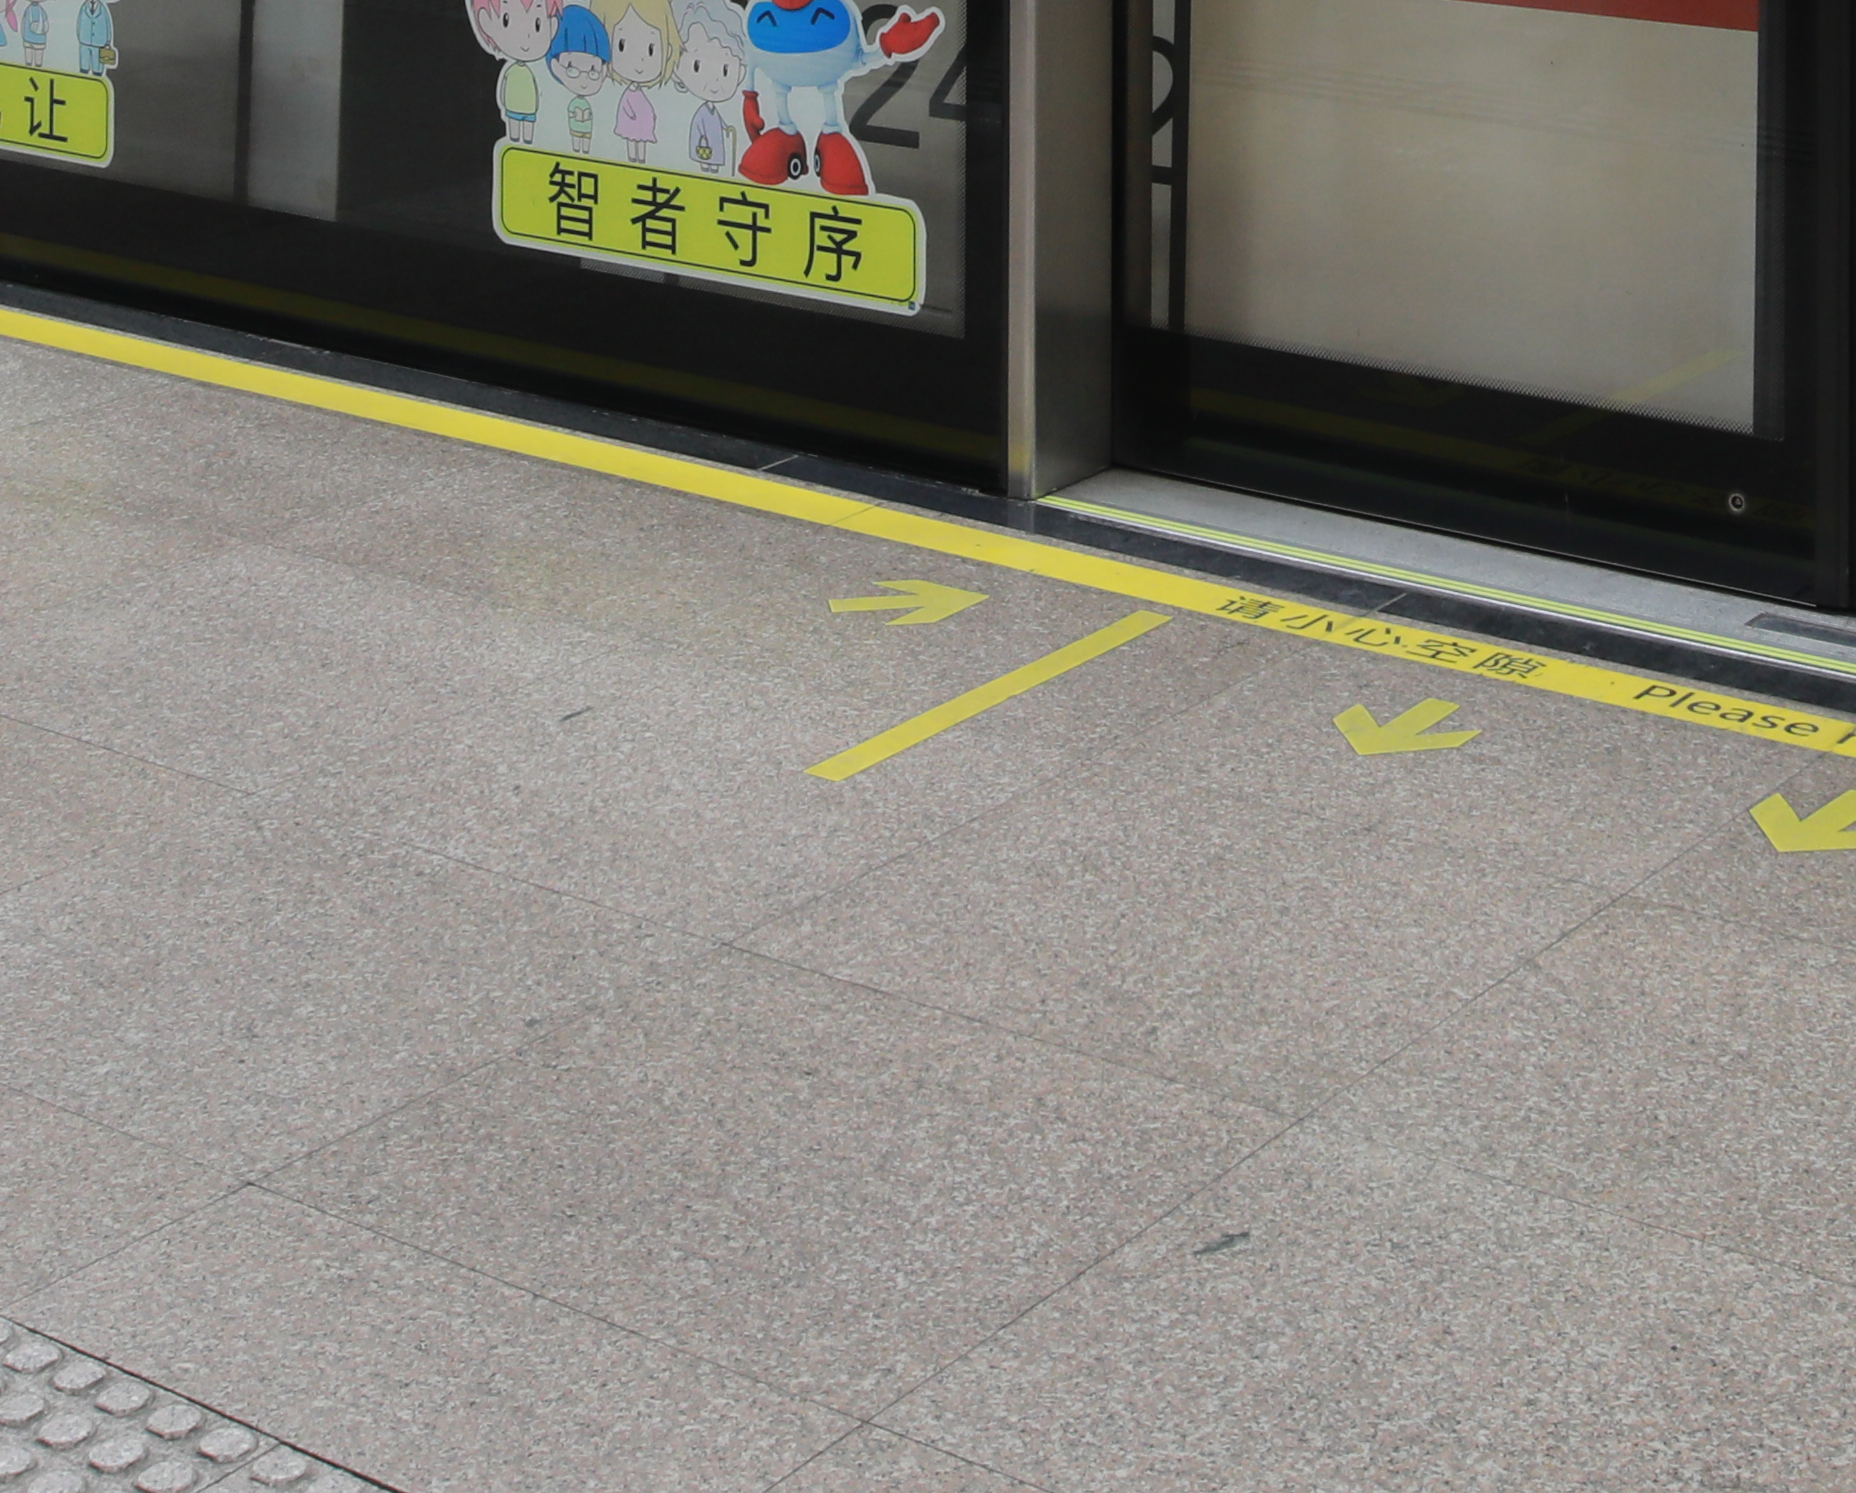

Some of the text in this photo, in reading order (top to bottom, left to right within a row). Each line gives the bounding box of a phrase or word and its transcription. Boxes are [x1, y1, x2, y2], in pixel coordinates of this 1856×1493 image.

[548, 161, 864, 283] 智者守序
[1216, 595, 1547, 680] 请小心空隙
[1634, 682, 1821, 739] Please
